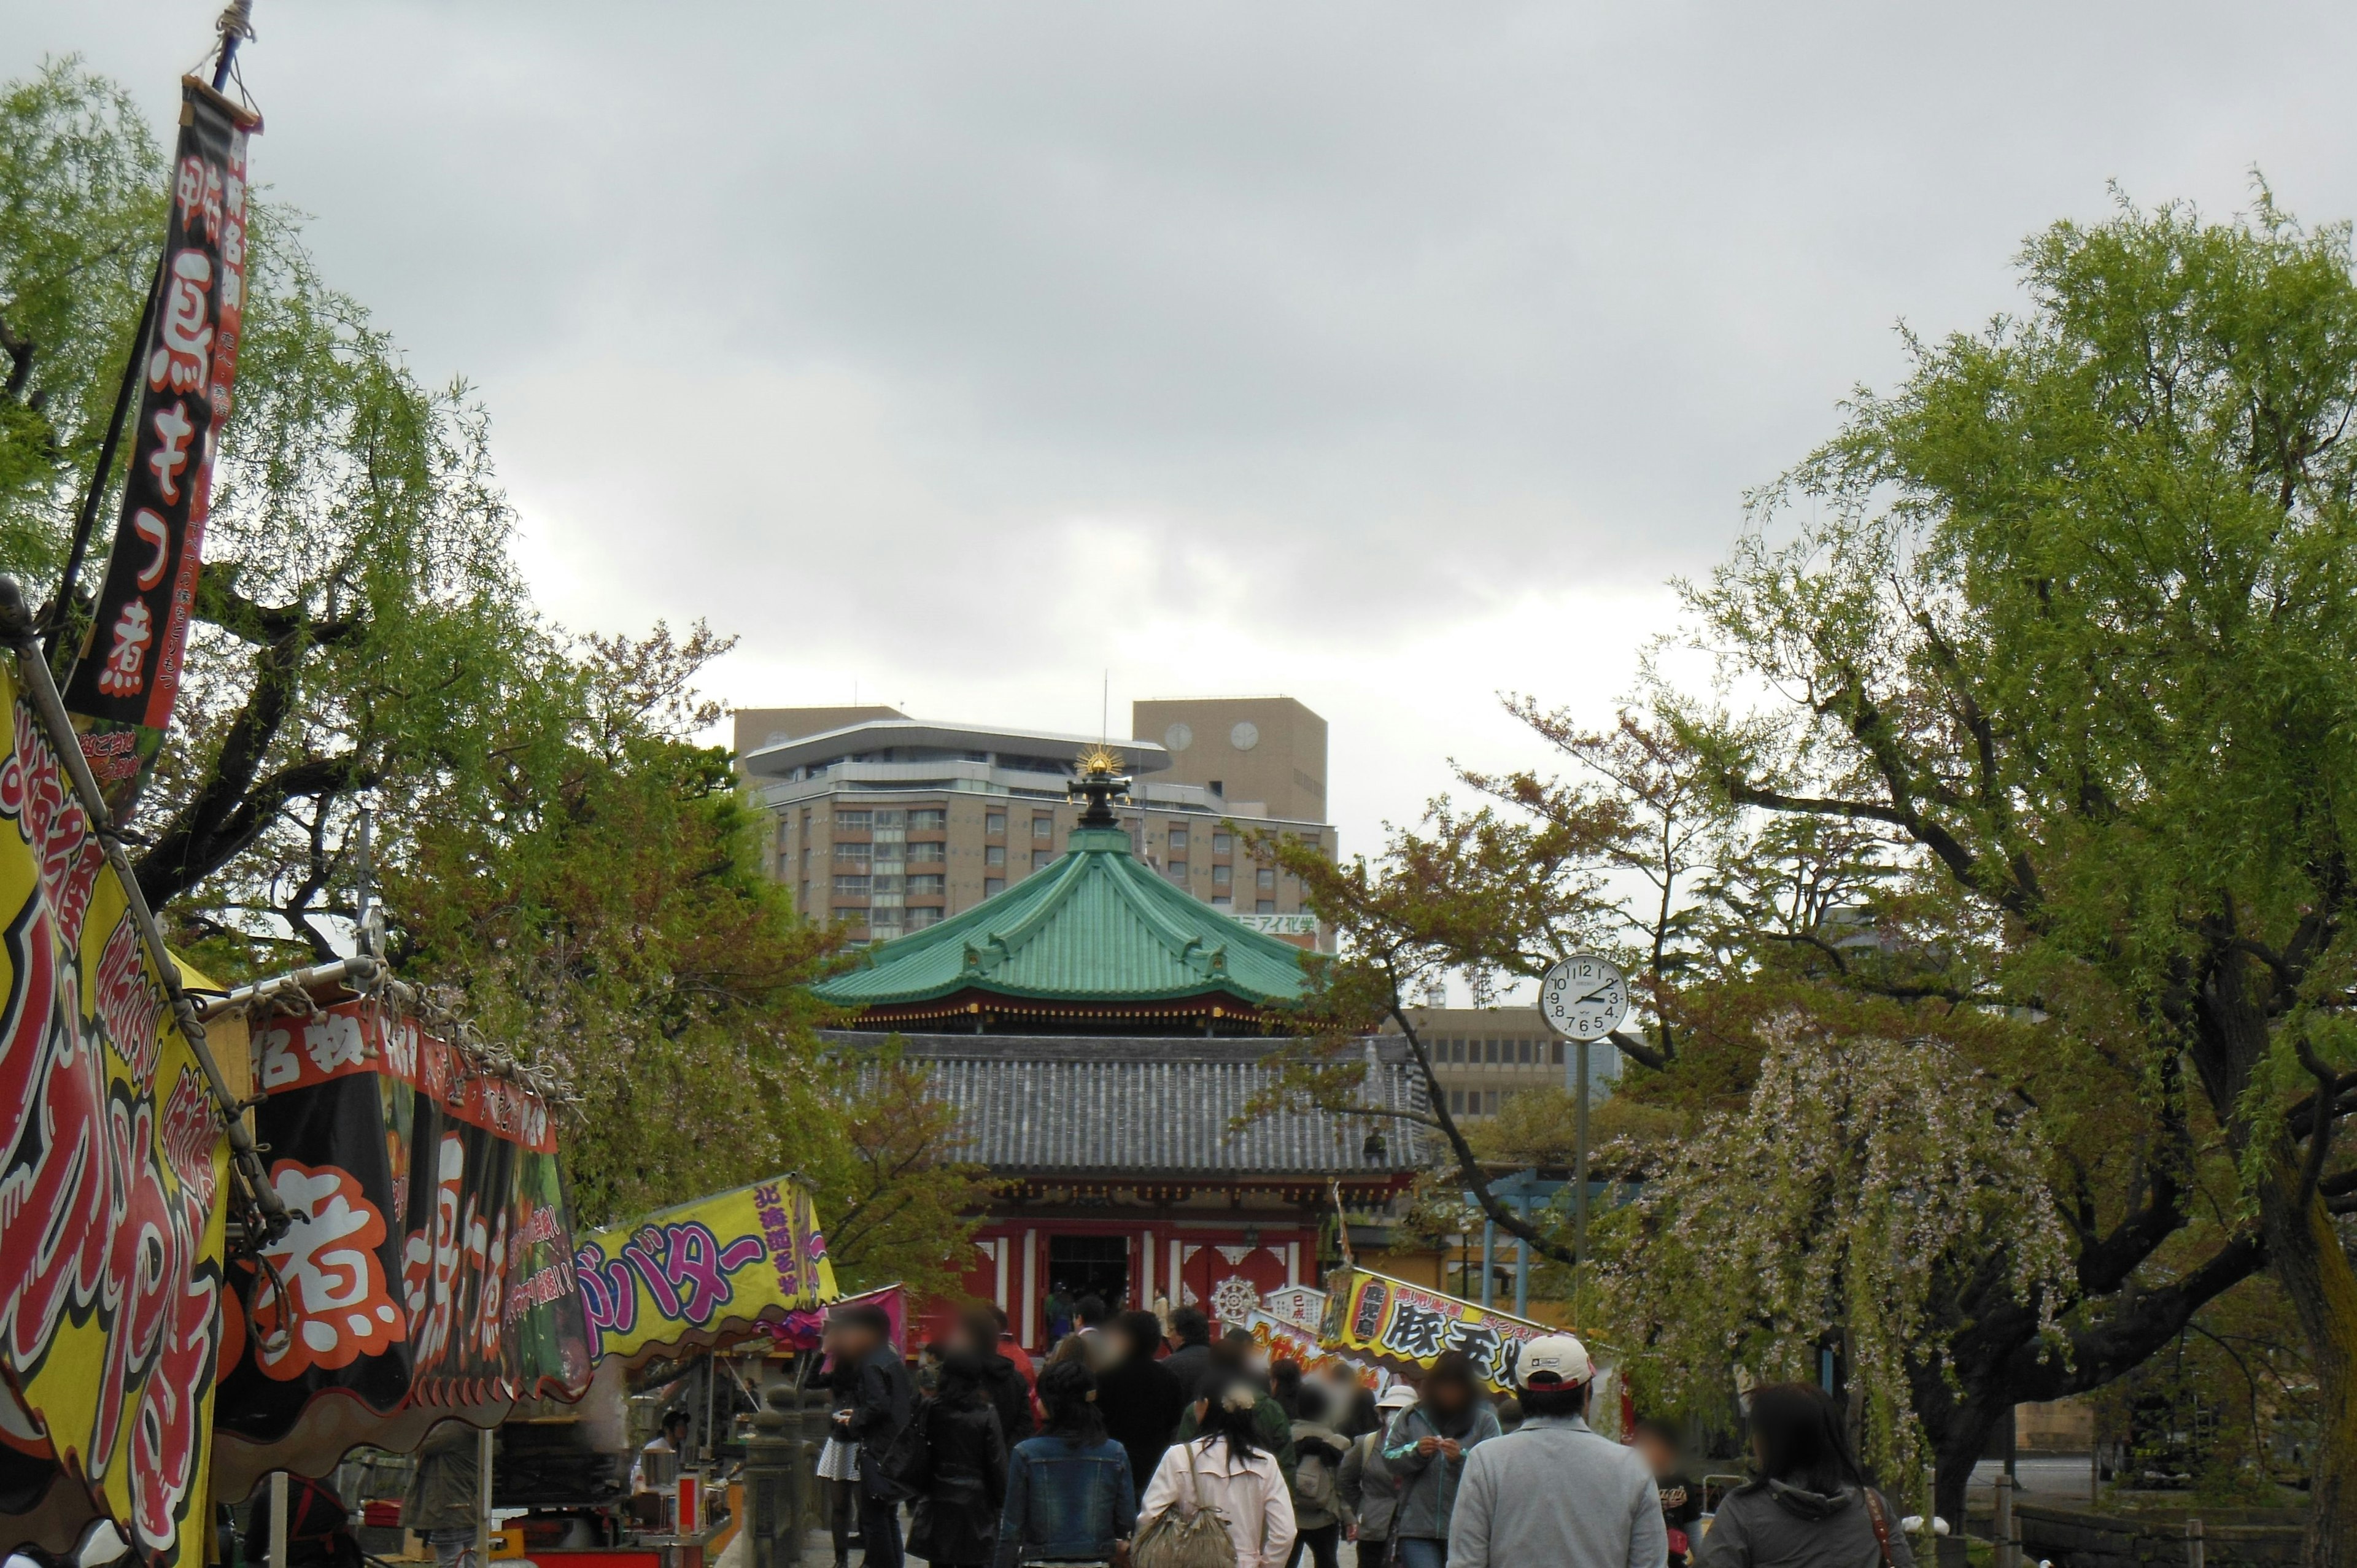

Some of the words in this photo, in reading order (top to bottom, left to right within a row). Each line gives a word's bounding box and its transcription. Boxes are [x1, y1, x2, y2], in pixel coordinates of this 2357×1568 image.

[1566, 968, 1576, 979] 11
[1579, 965, 1592, 977] 12
[1554, 978, 1566, 990] 10
[1606, 978, 1614, 989] 2
[1550, 992, 1560, 1005] 9
[1609, 992, 1618, 1005] 3
[1555, 1005, 1565, 1018] 8
[1604, 1006, 1614, 1018] 4
[1566, 1017, 1576, 1028] 7
[1579, 1020, 1589, 1032] 6
[1594, 1017, 1603, 1029] 5
[1355, 1284, 1387, 1338] 鹿児島
